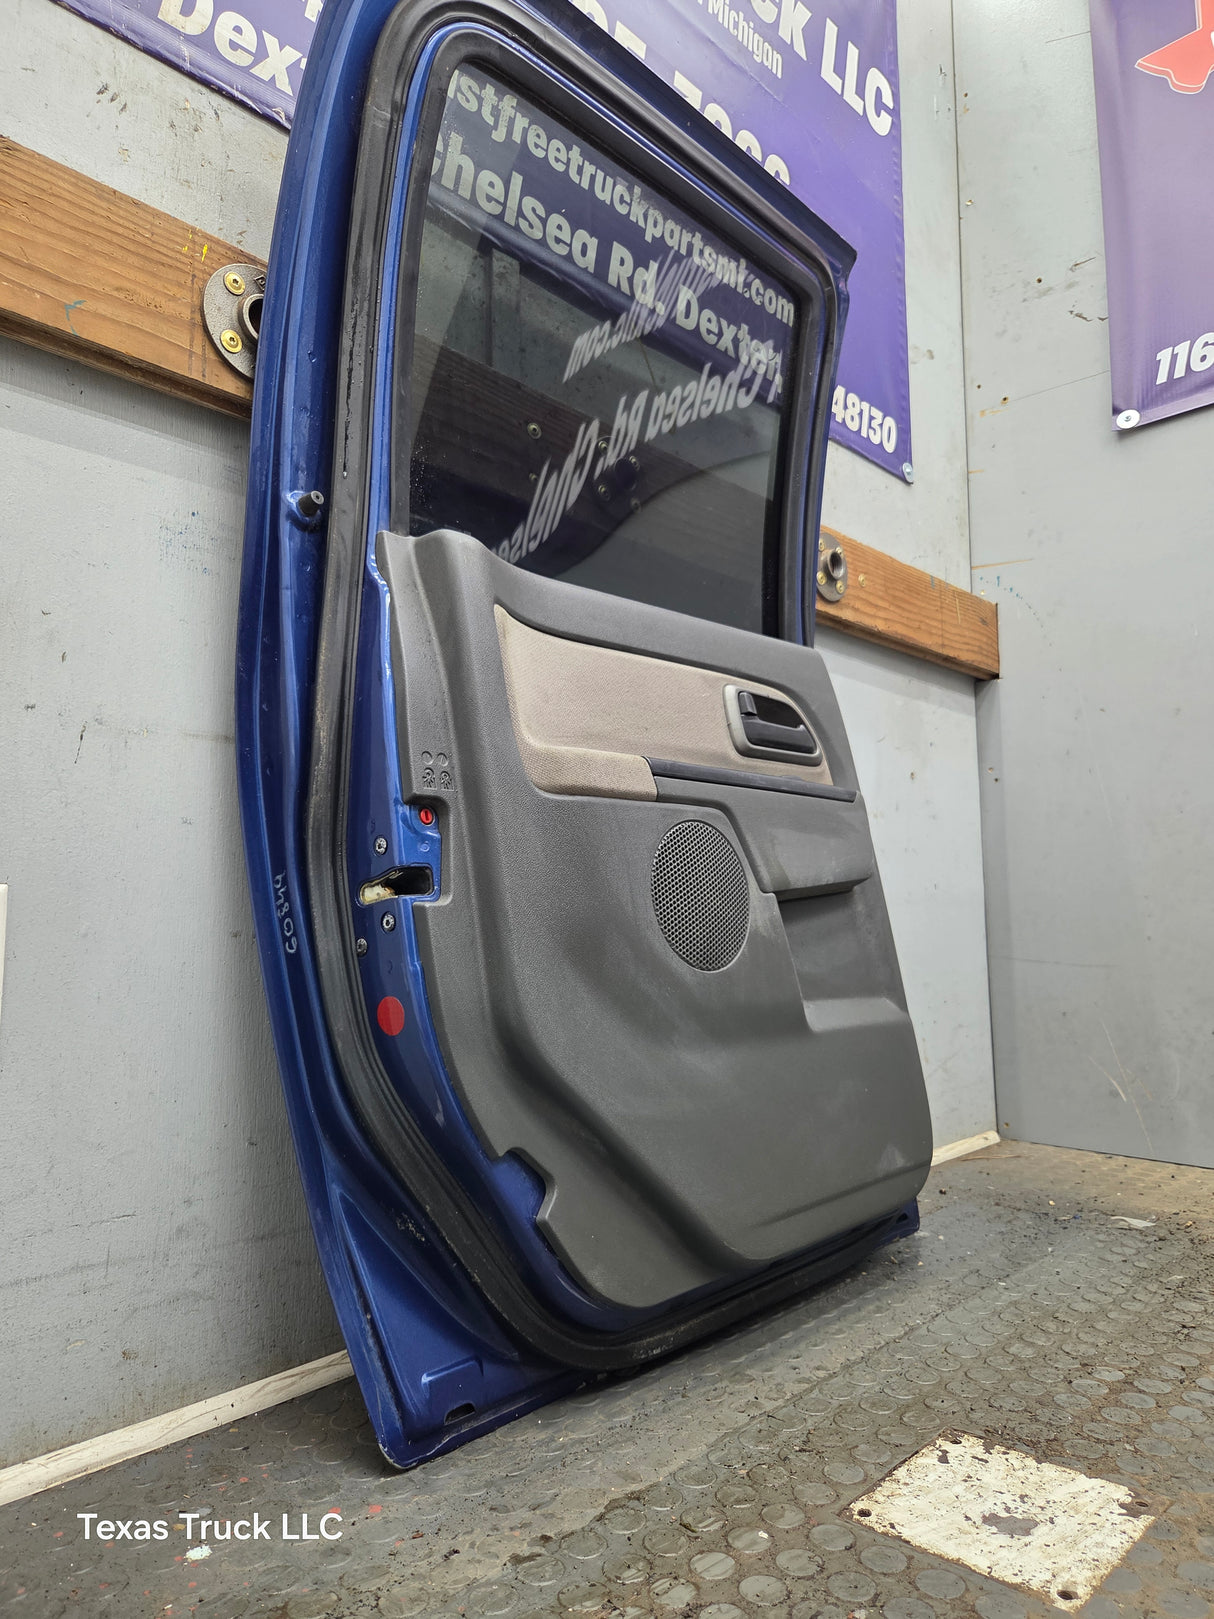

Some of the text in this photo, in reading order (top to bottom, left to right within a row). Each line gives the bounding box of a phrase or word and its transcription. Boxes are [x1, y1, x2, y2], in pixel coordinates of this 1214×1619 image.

[157, 0, 307, 97] Dex
[707, 0, 783, 79] Michigan
[820, 17, 894, 137] LLC
[1155, 331, 1214, 385] 116
[831, 384, 897, 454] 48130
